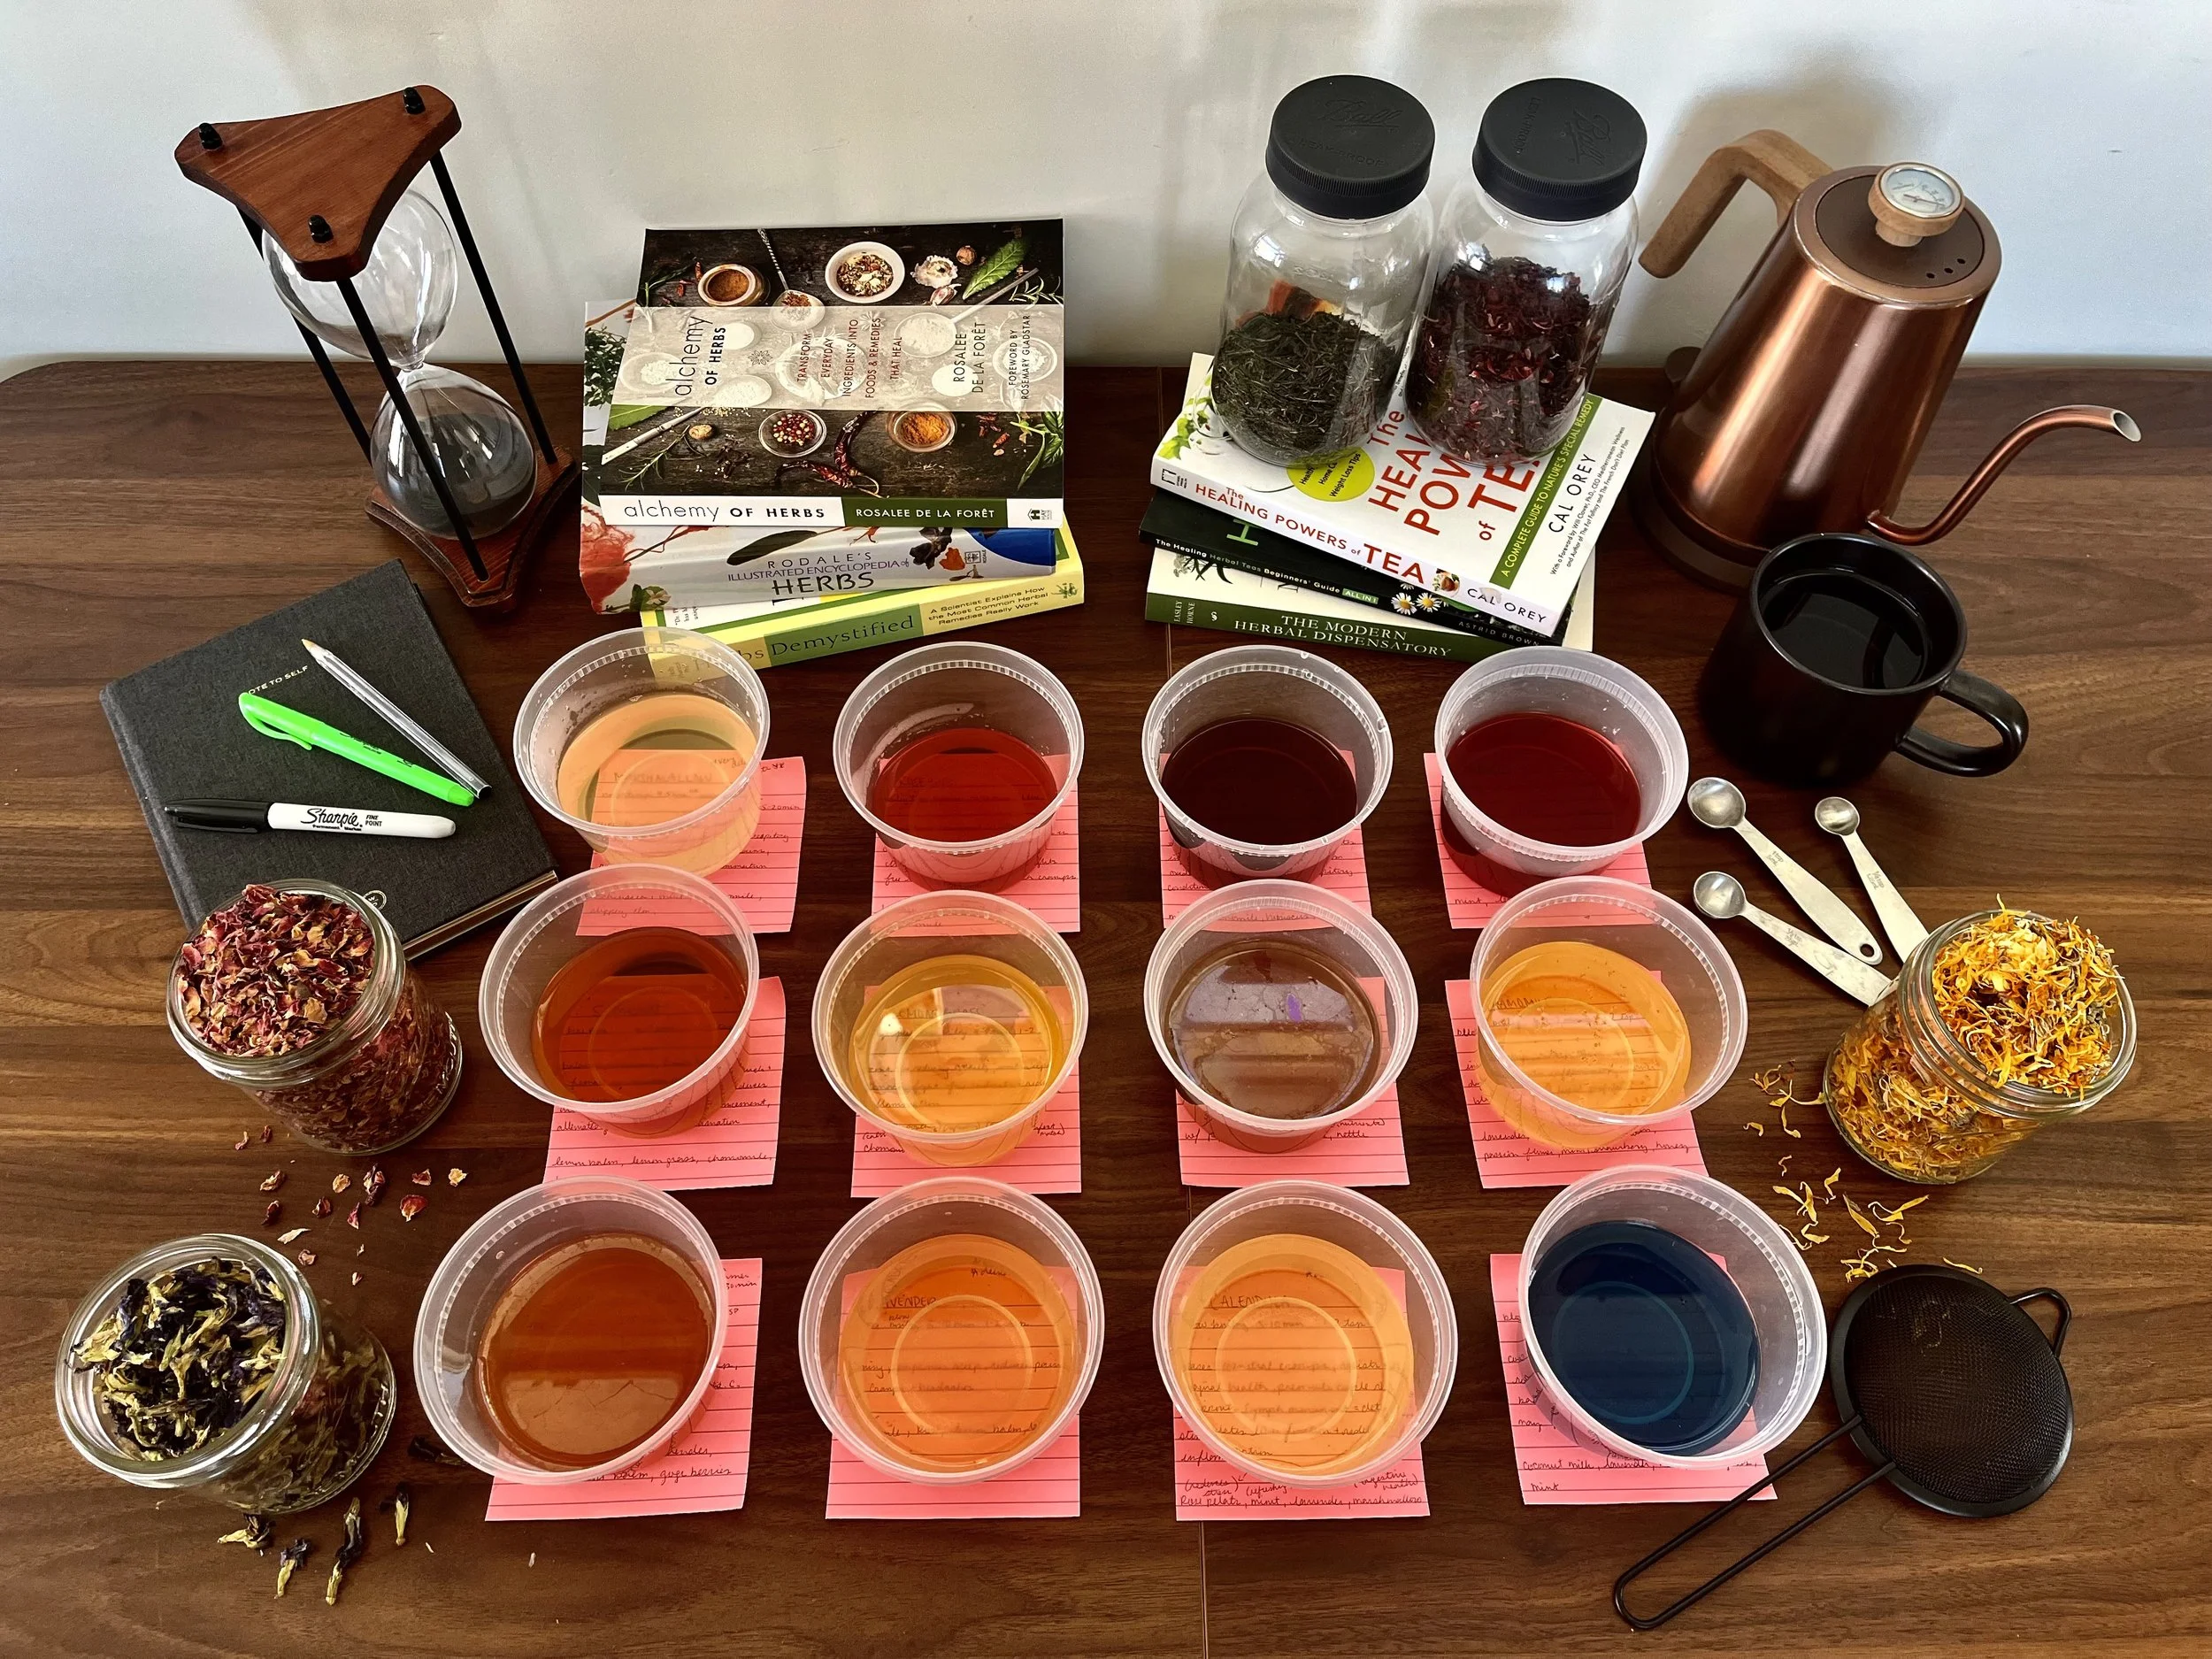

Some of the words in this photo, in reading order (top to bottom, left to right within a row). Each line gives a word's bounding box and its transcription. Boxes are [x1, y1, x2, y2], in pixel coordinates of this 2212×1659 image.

[1317, 98, 1404, 127] Ball
[1564, 107, 1611, 165] Ball
[709, 327, 726, 363] HERBS
[870, 318, 881, 357] REMEDIES
[893, 336, 902, 358] HEAL
[972, 322, 987, 357] FORÊT
[1010, 330, 1018, 340] BY
[665, 316, 713, 396] alchemy
[797, 333, 812, 382] TRANSFORM
[821, 338, 834, 378] EVERYDAY
[842, 343, 856, 396] INGREDIENTS
[849, 319, 859, 341] INTO
[953, 333, 967, 382] ROSALEE
[1009, 344, 1018, 386] FOREWORD
[705, 370, 718, 385] OF
[890, 360, 900, 380] THAT
[973, 361, 985, 377] LA
[1021, 357, 1031, 400] ROSEMARY
[865, 368, 877, 398] FOODS
[972, 380, 984, 393] DE
[1367, 410, 1405, 446] The
[1612, 426, 1625, 445] Wellness
[1349, 452, 1361, 465] Tips
[1597, 446, 1617, 479] Mediterranean
[1318, 470, 1333, 485] Home
[1344, 465, 1355, 478] Loss
[1505, 528, 1531, 568] COMPLETE
[1525, 503, 1543, 527] GUIDE
[1537, 491, 1548, 503] TO
[1543, 457, 1566, 491] NATURE'S
[1560, 427, 1581, 457] SPECIAL
[1574, 398, 1594, 428] REMEDY
[1592, 478, 1601, 489] CEO
[1225, 487, 1244, 500] The
[1329, 474, 1346, 497] Weight
[1548, 504, 1574, 533] CAL
[1566, 453, 1596, 496] OREY
[624, 499, 719, 522] alchemy
[730, 508, 753, 518] OF
[766, 508, 825, 518] HERBS
[1571, 541, 1581, 558] Author
[1589, 503, 1601, 520] Fallacy
[1604, 471, 1615, 486] French
[1621, 439, 1630, 449] Plan
[856, 509, 910, 518] ROSALEE
[957, 507, 995, 518] FORÊT
[1572, 518, 1581, 529] Will
[1195, 483, 1268, 519] HEALING
[1275, 514, 1348, 549] POWERS
[1351, 547, 1361, 556] of
[1363, 542, 1425, 585] TEA
[1479, 520, 1495, 541] of
[1570, 529, 1578, 538] by
[1558, 535, 1573, 559] Foreword
[728, 567, 804, 581] ILLUSTRATED
[807, 560, 901, 575] ENCYCLOPEDIA
[900, 558, 910, 568] of
[768, 551, 872, 569] RODALE'S
[1156, 538, 1171, 548] The
[1173, 543, 1207, 558] Healing
[1210, 553, 1239, 566] Herbal
[1241, 562, 1262, 572] Teas
[1314, 581, 1340, 594] Guide
[1345, 590, 1362, 600] ALL
[1550, 563, 1560, 575] With
[772, 572, 874, 595] HERBS
[941, 600, 983, 613] Scientist
[985, 591, 1022, 603] Explains
[1025, 586, 1046, 595] How
[947, 608, 972, 618] Most
[975, 600, 1015, 612] Common
[1018, 593, 1048, 603] Herbal
[1173, 600, 1183, 623] EASLEY
[1467, 588, 1496, 606] CAL
[1504, 603, 1547, 624] OREY
[939, 613, 983, 626] Remedies
[986, 607, 1013, 617] Really
[1015, 601, 1039, 611] Work
[1187, 602, 1195, 624] HORNE
[771, 615, 915, 657] Demystified
[1234, 620, 1308, 640] HERBAL
[1314, 631, 1452, 657] DISPENSATORY
[1280, 615, 1319, 630] THE
[1325, 621, 1408, 641] MODERN
[1458, 621, 1496, 635] ASTRID
[1502, 633, 1540, 646] BROWN
[247, 681, 269, 695] OTE
[269, 676, 283, 686] TO
[284, 665, 310, 680] SELF
